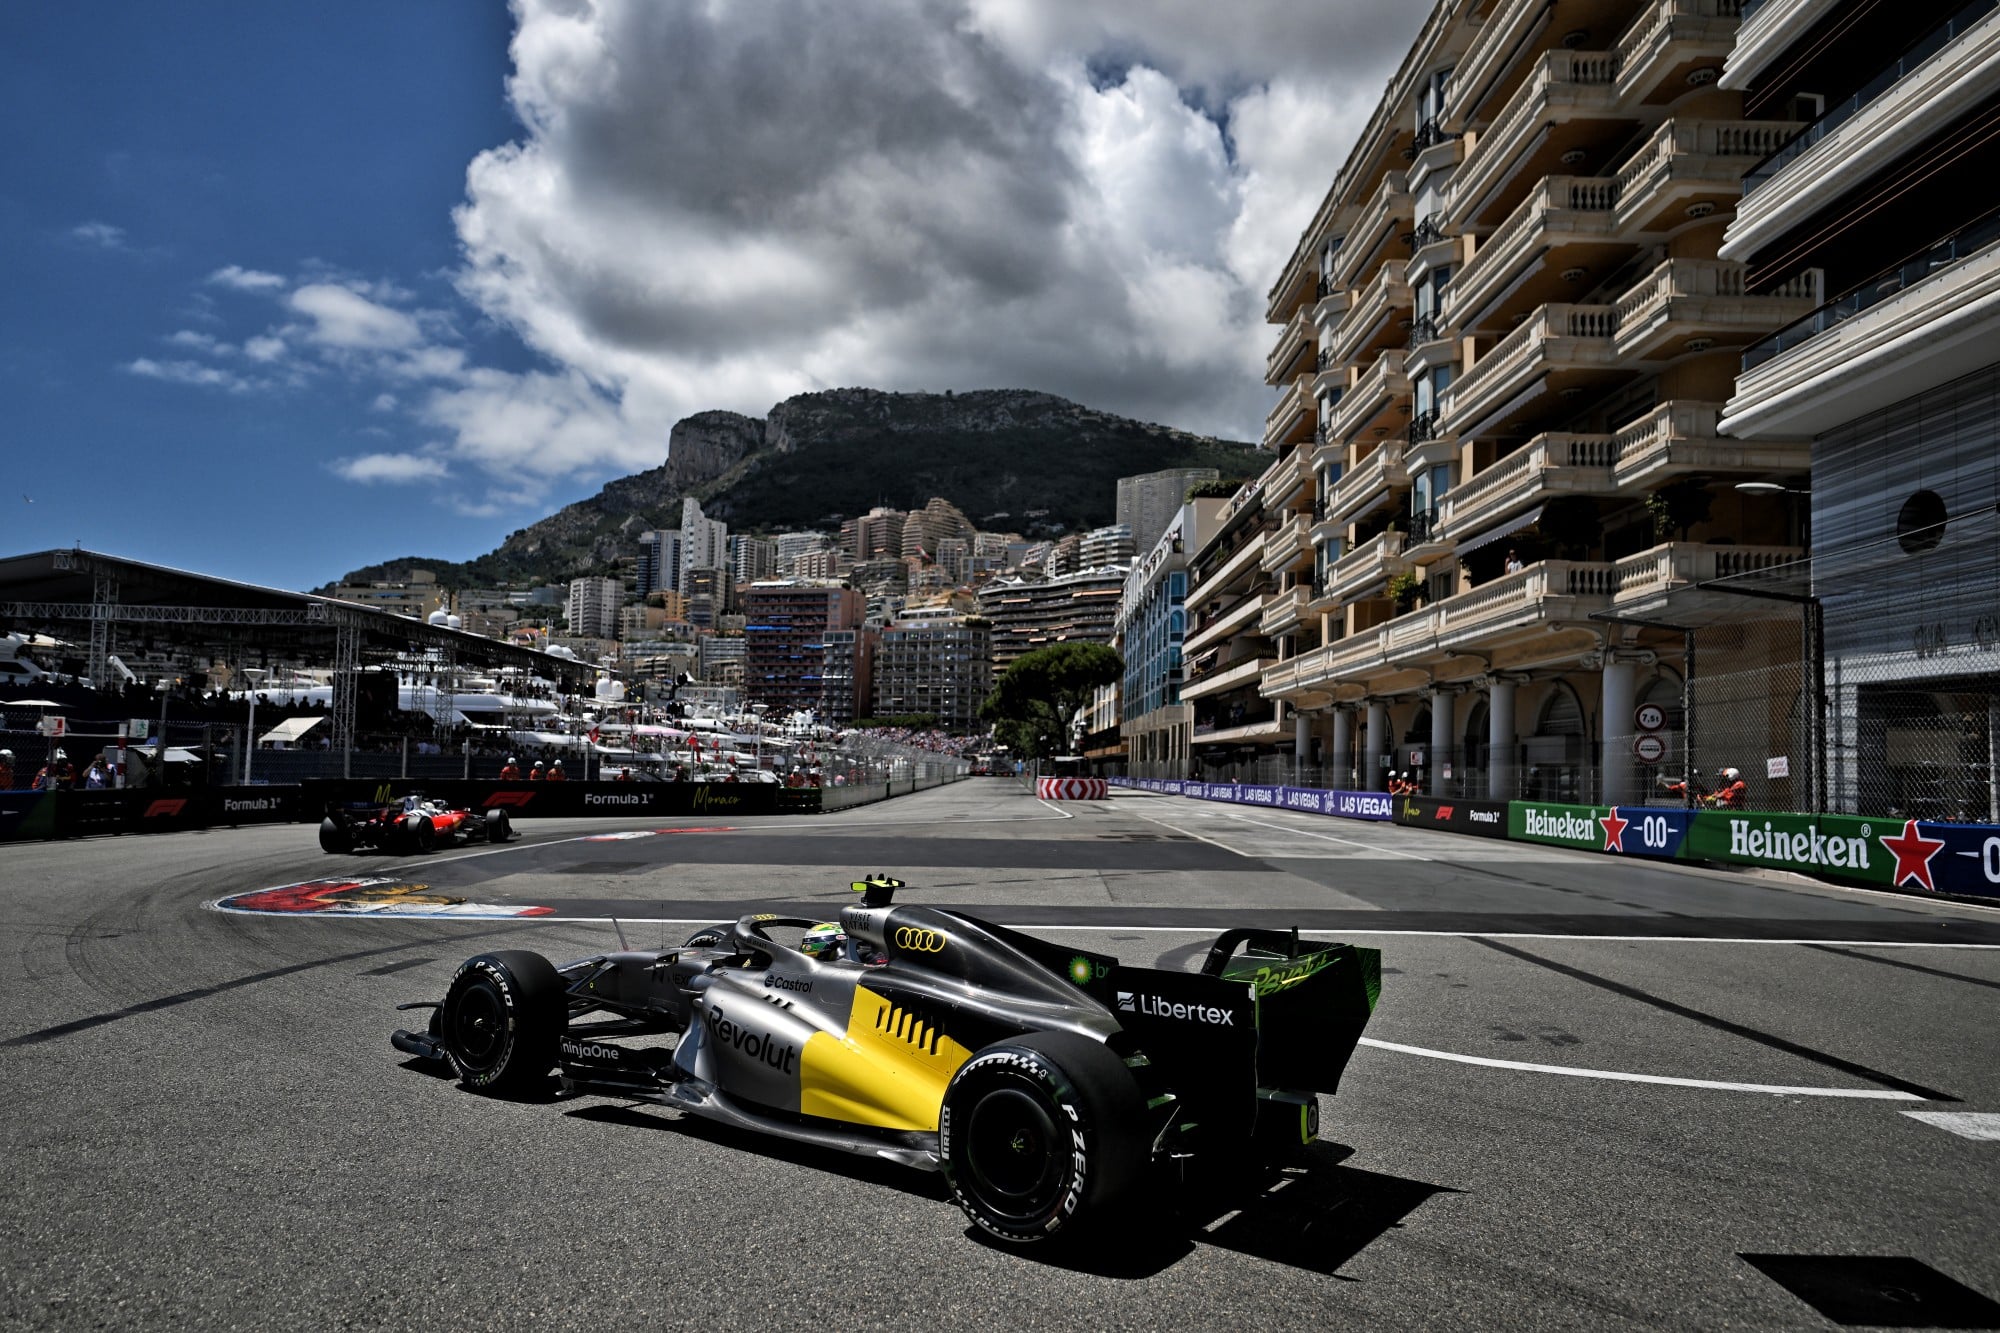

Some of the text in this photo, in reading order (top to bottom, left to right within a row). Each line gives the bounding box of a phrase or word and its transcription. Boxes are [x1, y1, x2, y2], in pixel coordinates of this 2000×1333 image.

[584, 793, 639, 805] Formula
[693, 784, 741, 813] Monaco
[1244, 788, 1254, 801] LAS
[1254, 789, 1272, 802] VEGAS
[1287, 791, 1299, 806] LAS
[1300, 793, 1320, 809] VEGAS
[224, 798, 268, 812] Formula
[1340, 796, 1355, 814] LAS
[1469, 809, 1493, 822] Formula
[850, 912, 871, 922] visit
[475, 961, 514, 1007] P ZERO
[774, 976, 814, 993] Castrol
[1140, 993, 1234, 1027] Libertex
[708, 1004, 795, 1075] Revolut
[562, 1041, 620, 1060] ninjaOne
[1061, 1103, 1087, 1216] P ZERO
